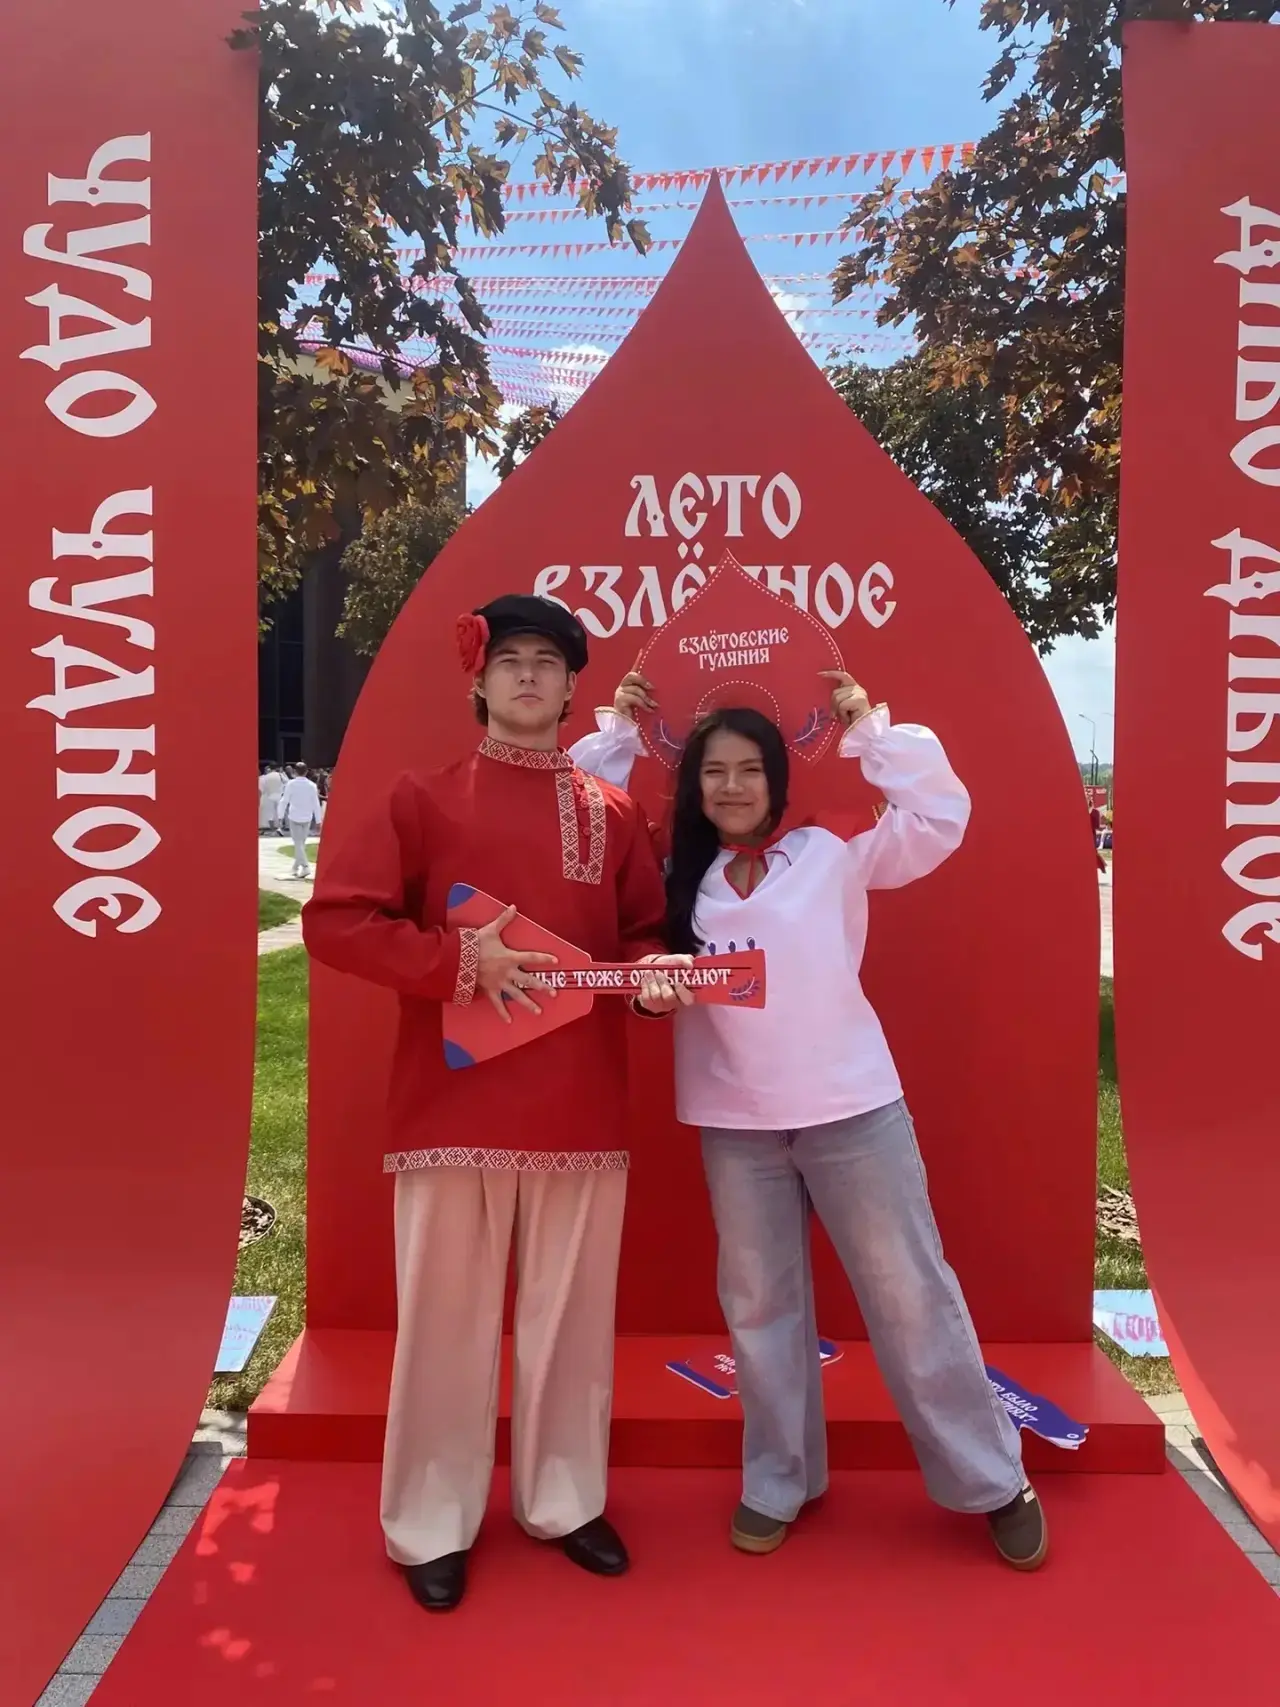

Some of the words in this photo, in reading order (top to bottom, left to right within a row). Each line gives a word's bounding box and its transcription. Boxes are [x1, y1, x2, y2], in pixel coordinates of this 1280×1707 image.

[19, 131, 157, 437] ЧУДО
[624, 471, 801, 539] ЛЕТО
[533, 542, 897, 638] ВЗЛЁНОЕ
[679, 627, 789, 654] ВЗЛЁТОВСКИЕ
[699, 648, 770, 671] ГУЛЯНИЯ
[25, 485, 161, 937] ЧУДНОЕ
[573, 969, 624, 988] ТОЖЕ
[630, 968, 731, 987] ОЫХАЮТ
